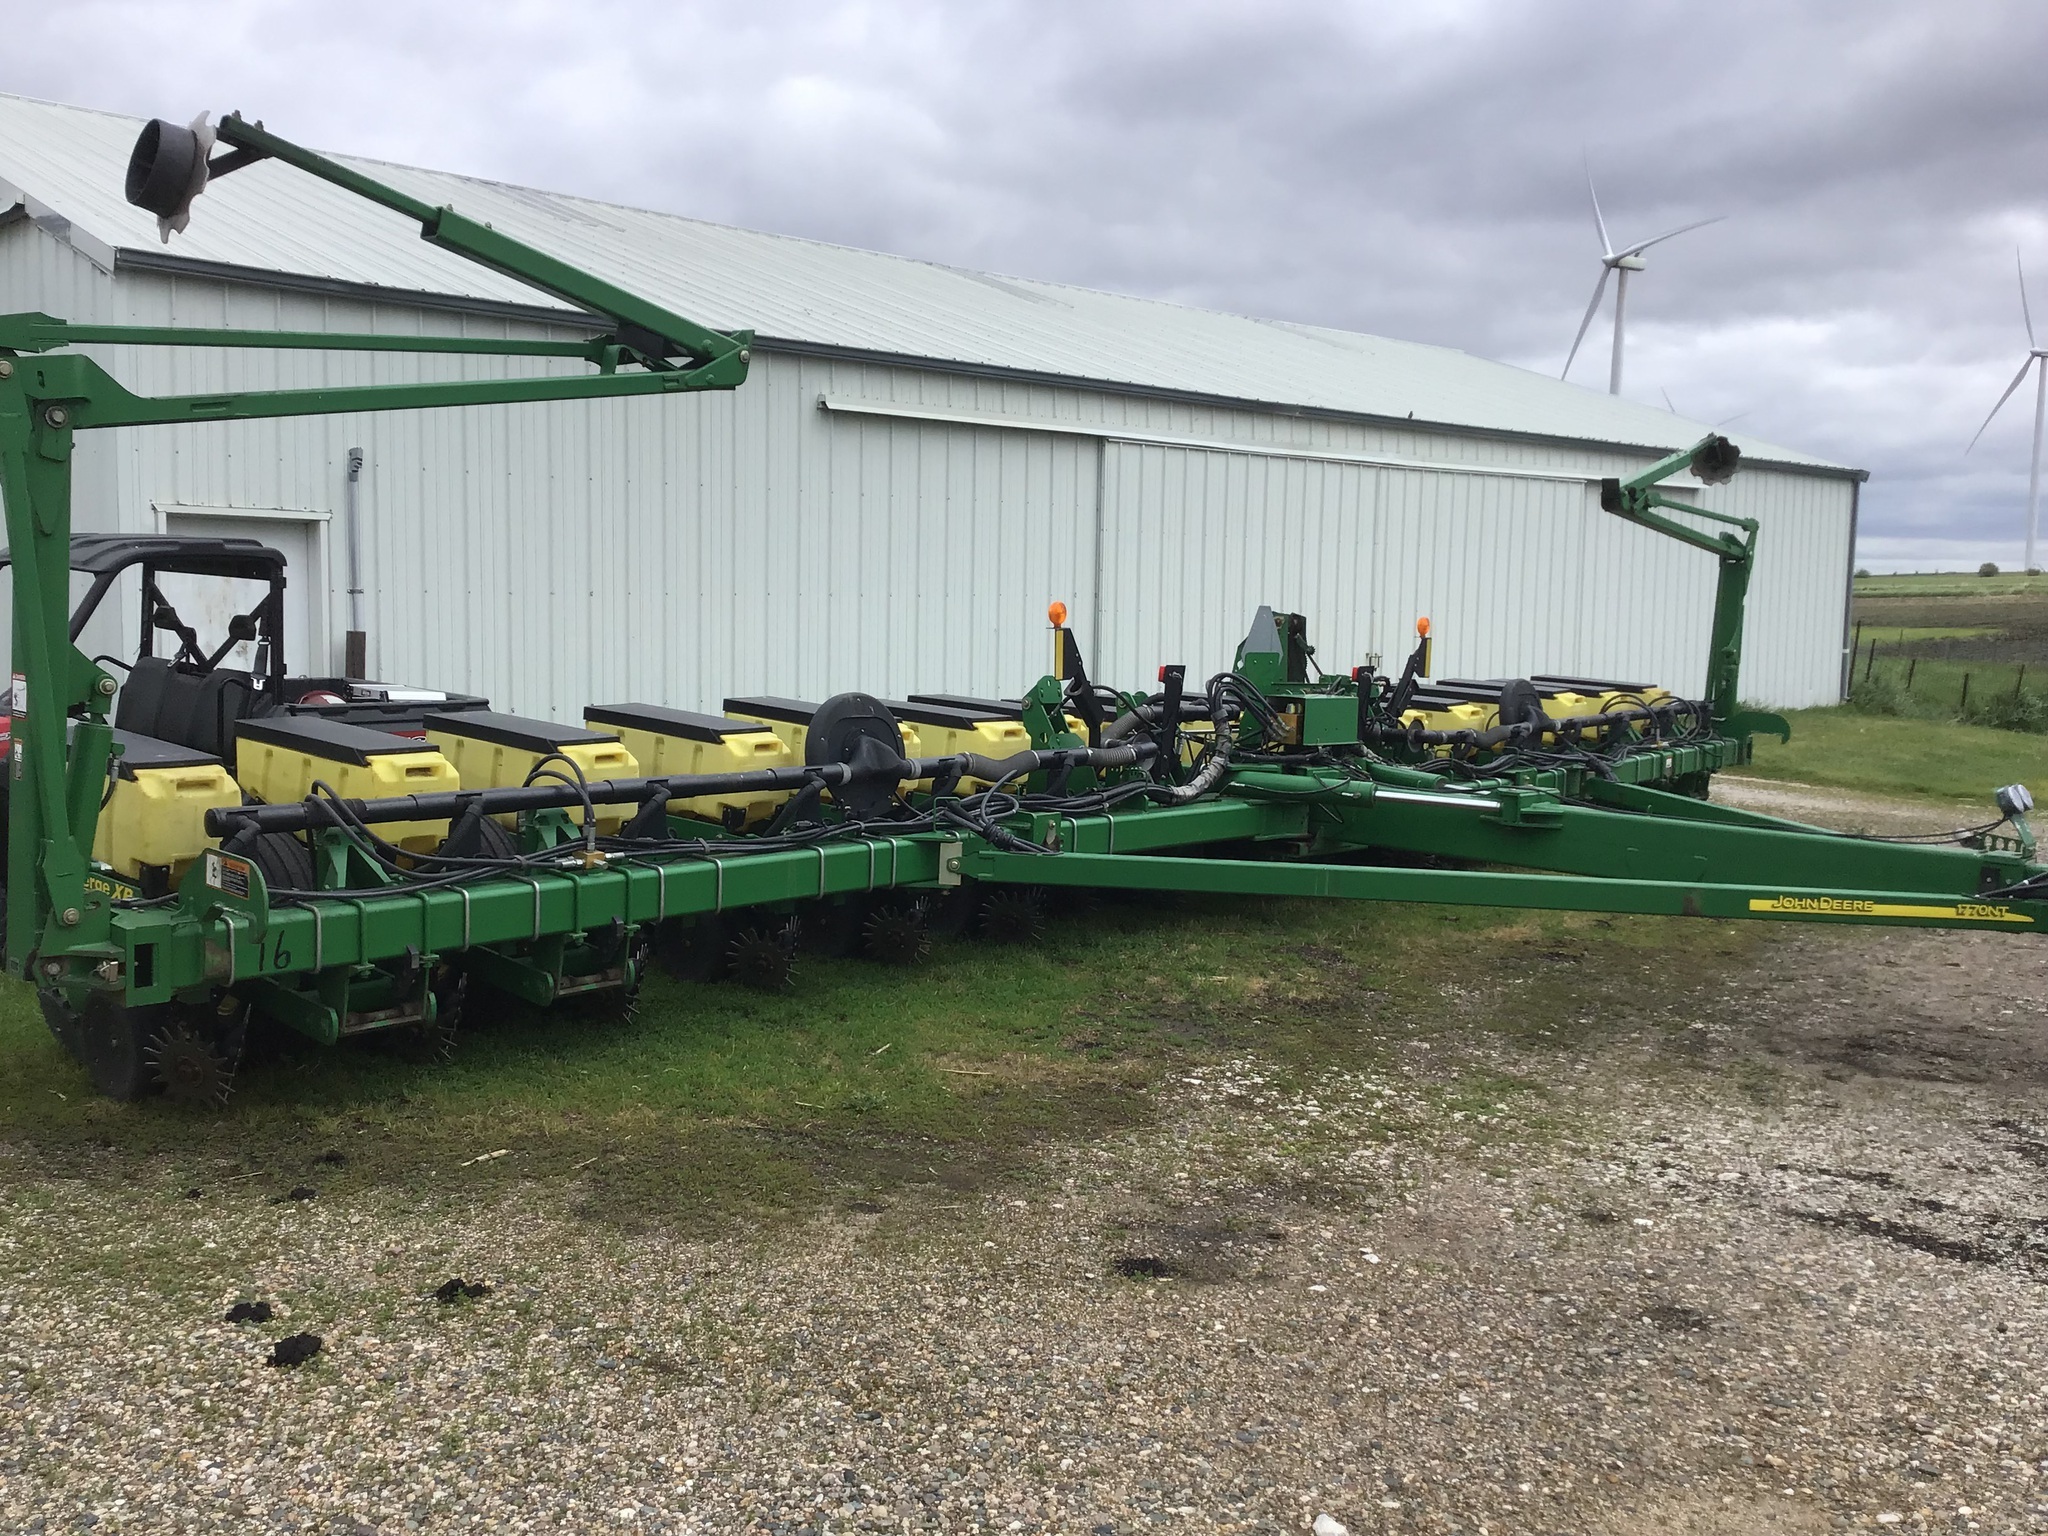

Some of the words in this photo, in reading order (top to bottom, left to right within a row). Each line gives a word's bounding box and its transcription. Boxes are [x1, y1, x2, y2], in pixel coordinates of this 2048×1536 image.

[83, 877, 110, 896] erge
[1772, 895, 1818, 910] JOHN
[1818, 897, 1874, 912] DEERE
[1955, 903, 2009, 918] 1770NT
[258, 930, 292, 972] 16
